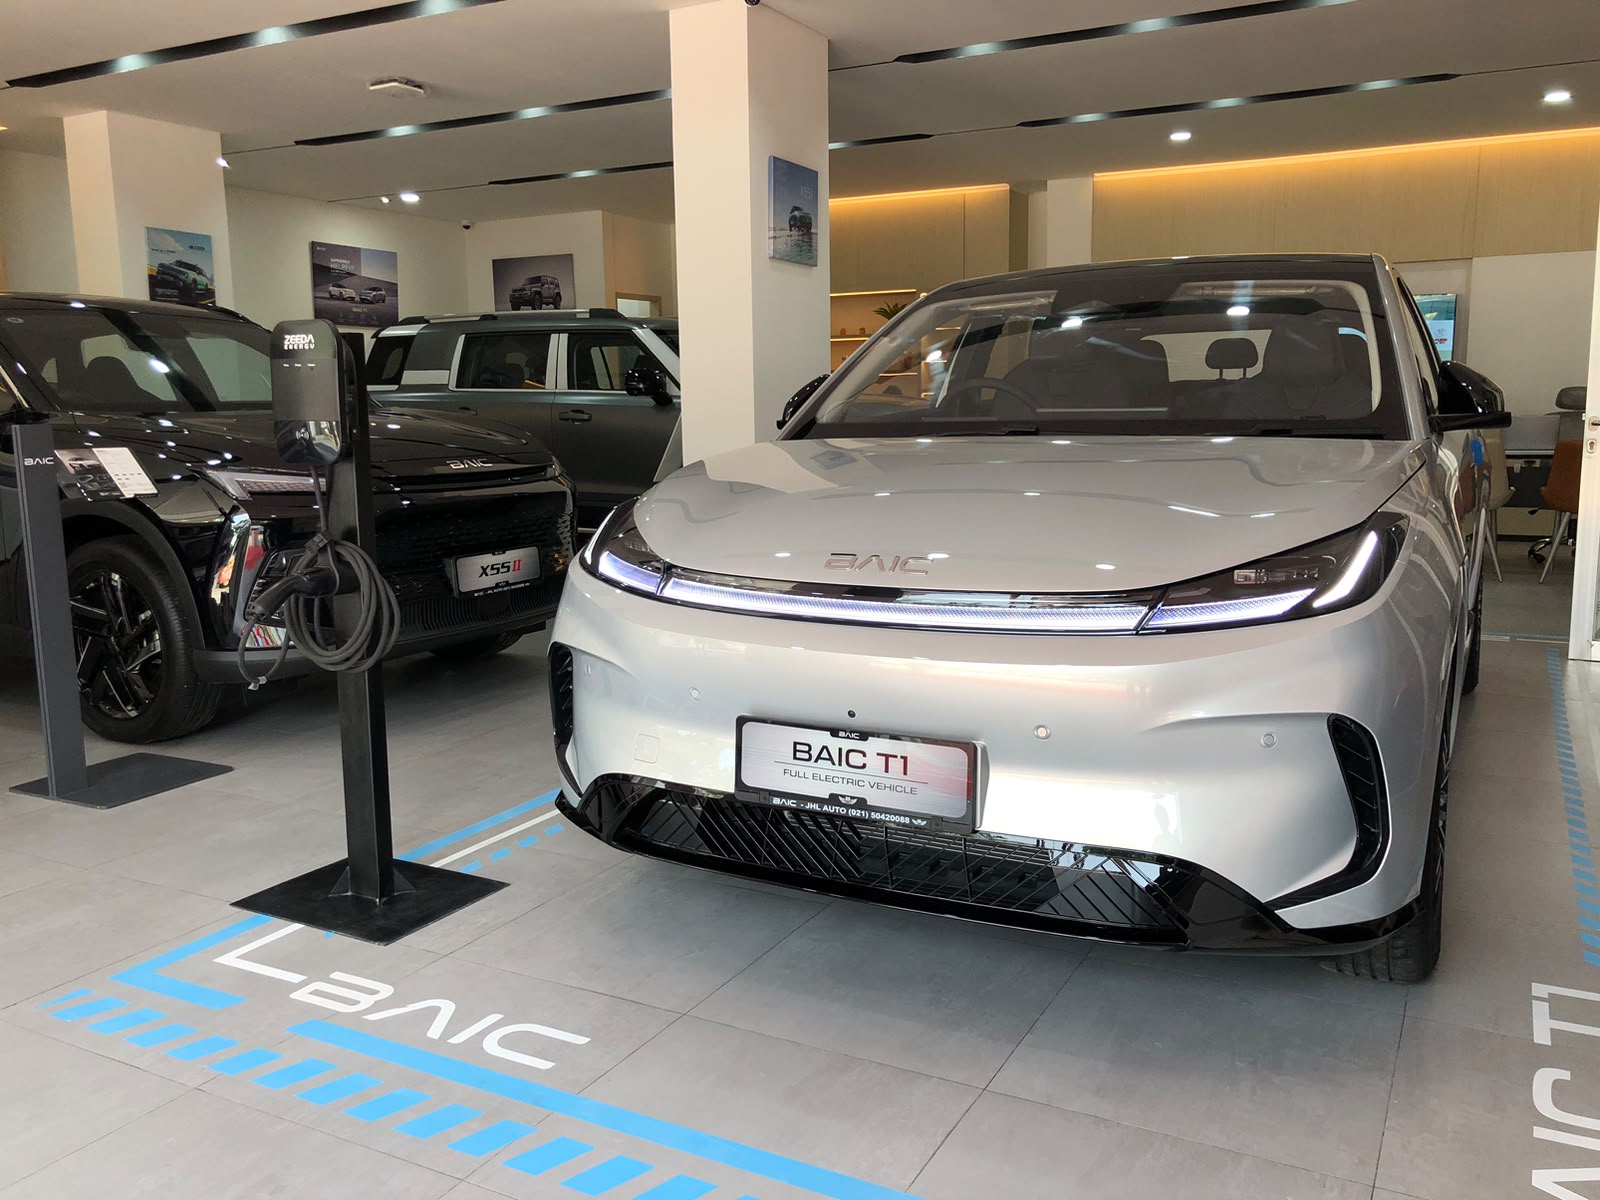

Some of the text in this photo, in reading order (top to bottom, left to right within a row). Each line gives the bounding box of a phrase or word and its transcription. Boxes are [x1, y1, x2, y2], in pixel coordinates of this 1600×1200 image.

[284, 334, 315, 344] ZEEDA
[24, 457, 54, 466] BAIC
[446, 458, 493, 469] BAIC
[824, 552, 934, 575] BAIC
[838, 731, 860, 739] BAIC
[792, 741, 908, 776] BAIC T1
[783, 768, 918, 795] FULL ELECTRIC VEHICLE
[772, 797, 797, 807] BAIC
[805, 802, 821, 811] JHL
[822, 805, 847, 814] AUTO
[848, 808, 869, 819] (021)
[870, 812, 910, 824] 50420088
[289, 971, 591, 1070] BAIC
